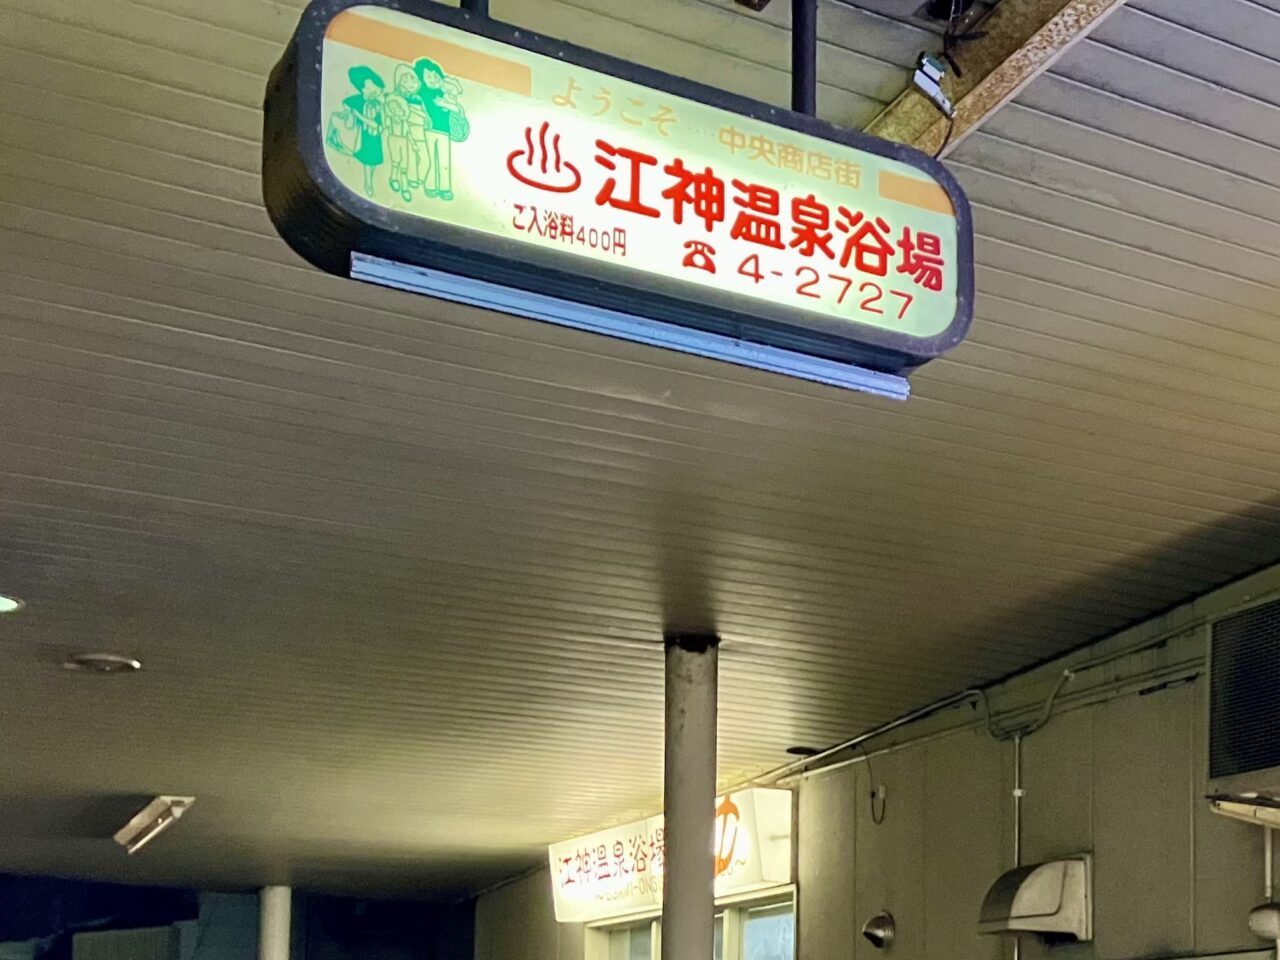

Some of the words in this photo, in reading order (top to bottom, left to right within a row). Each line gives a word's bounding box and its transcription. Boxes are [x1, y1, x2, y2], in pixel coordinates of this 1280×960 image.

[551, 77, 678, 137] ようこそ
[718, 125, 863, 190] 中央商店街
[512, 203, 627, 257] ご入浴料400円
[594, 139, 945, 292] 江神温泉浴場
[737, 253, 914, 320] 4-2727
